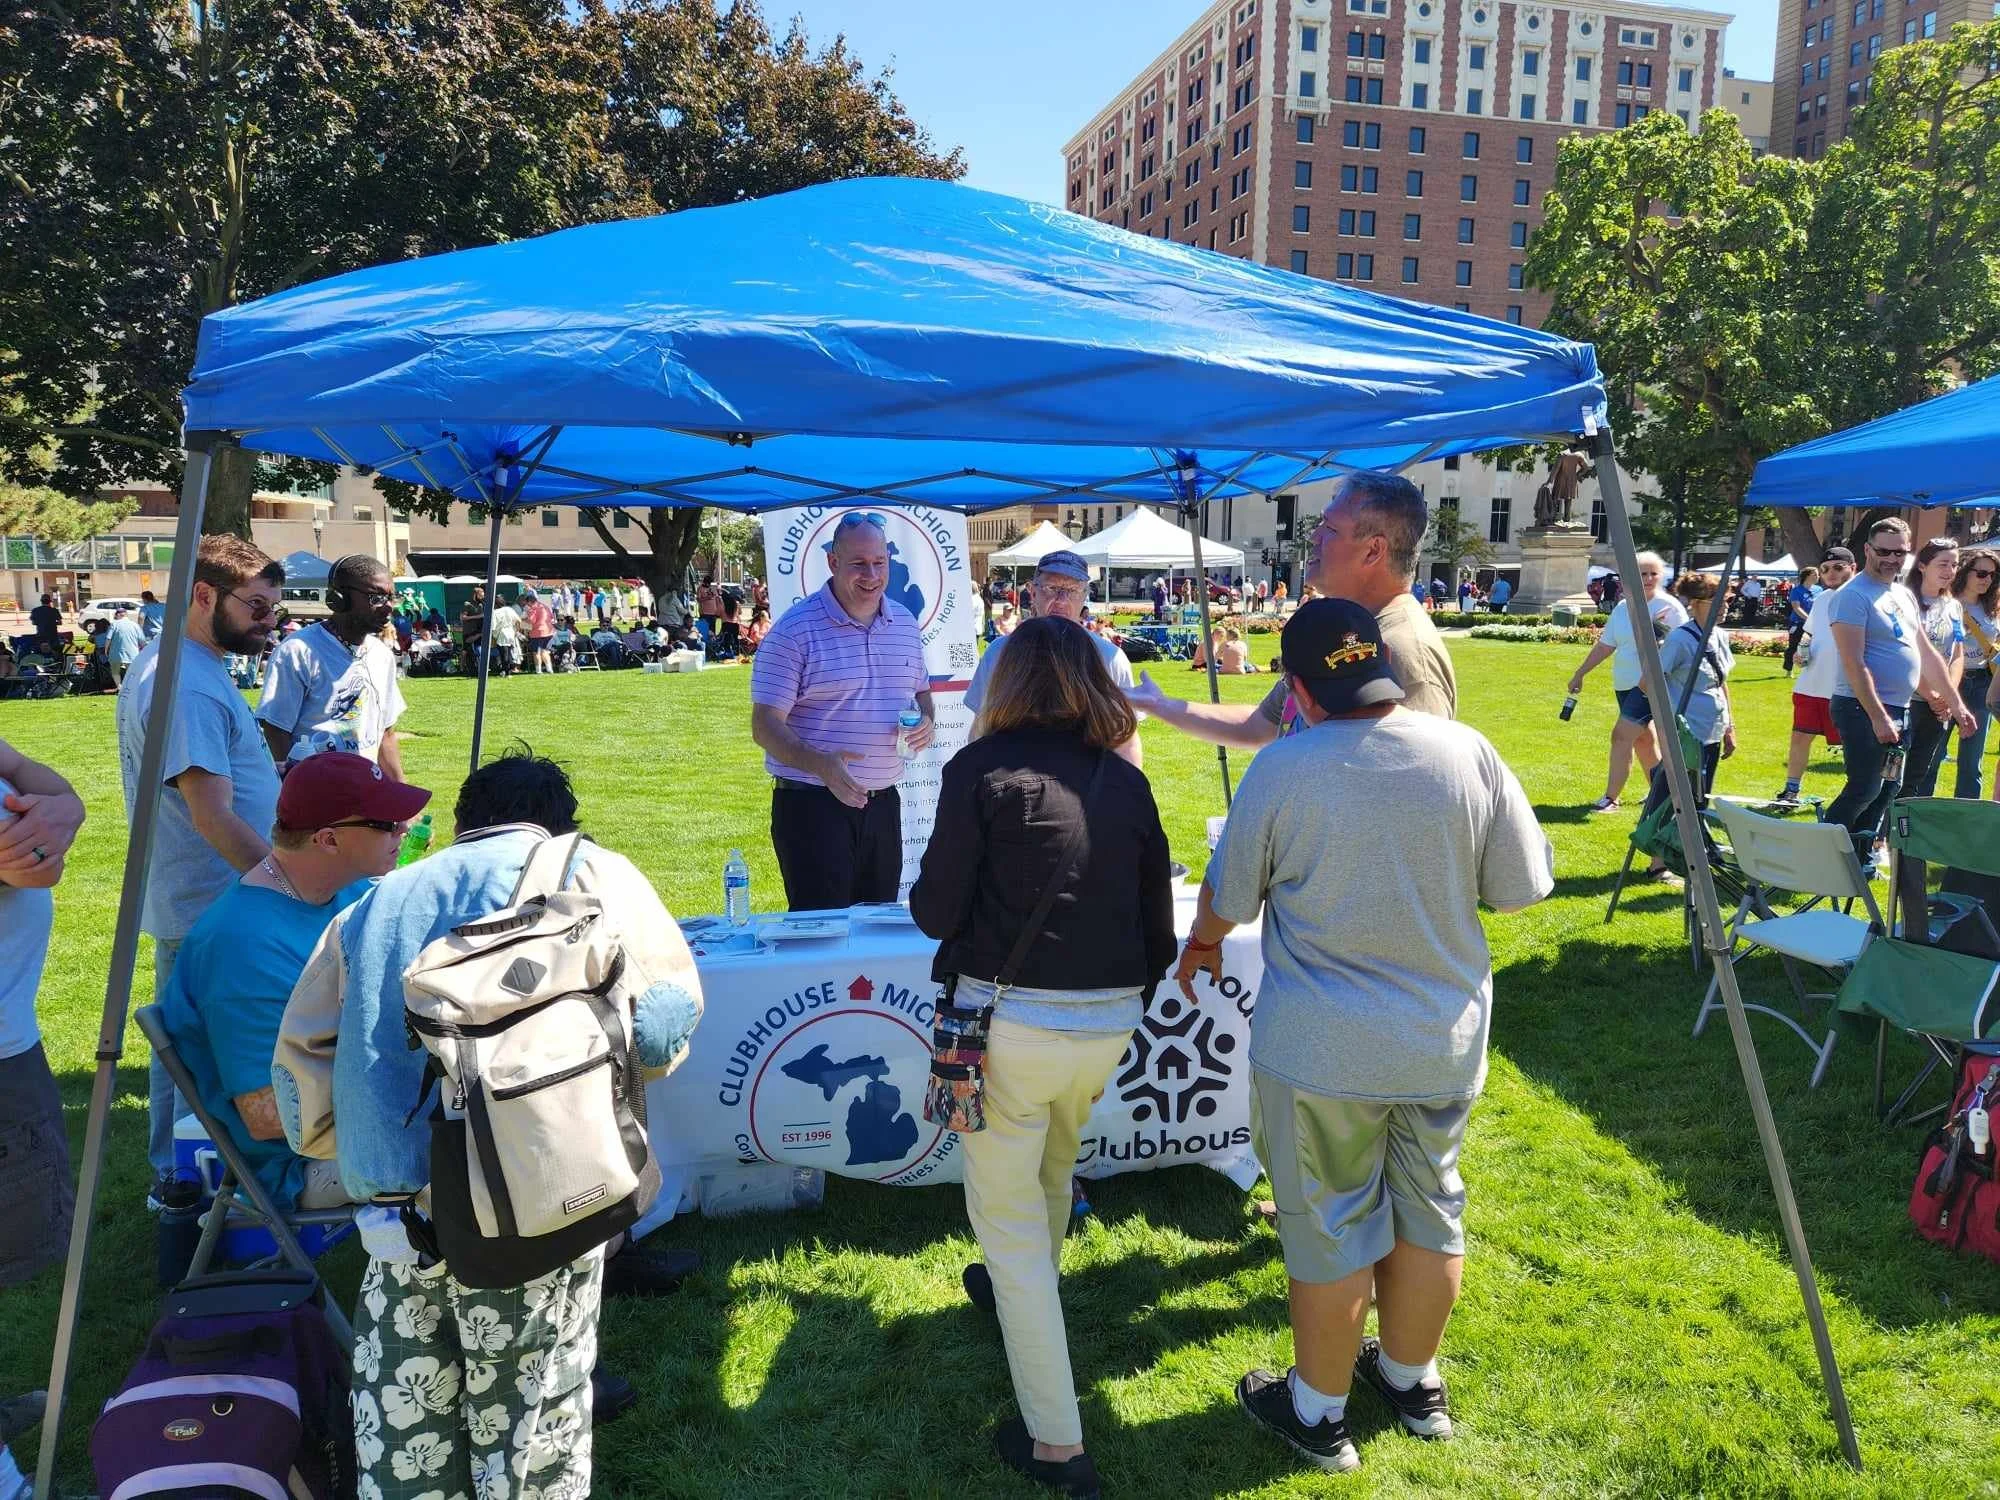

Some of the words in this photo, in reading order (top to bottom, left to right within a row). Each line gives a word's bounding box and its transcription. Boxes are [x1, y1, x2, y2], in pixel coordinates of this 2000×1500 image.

[778, 506, 829, 575] CLUBHO
[903, 505, 962, 571] CHIGAN
[941, 588, 957, 624] Hope.
[934, 721, 965, 730] bhouse
[896, 779, 938, 789] ortunities
[907, 799, 918, 808] by
[719, 981, 837, 1106] CLUBHOUSE
[782, 1132, 801, 1143] EST
[804, 1130, 832, 1142] 1996
[1075, 1127, 1250, 1164] Clubhous
[735, 1133, 758, 1160] Com
[888, 1163, 937, 1185] nities.
[932, 1132, 960, 1161] Hop
